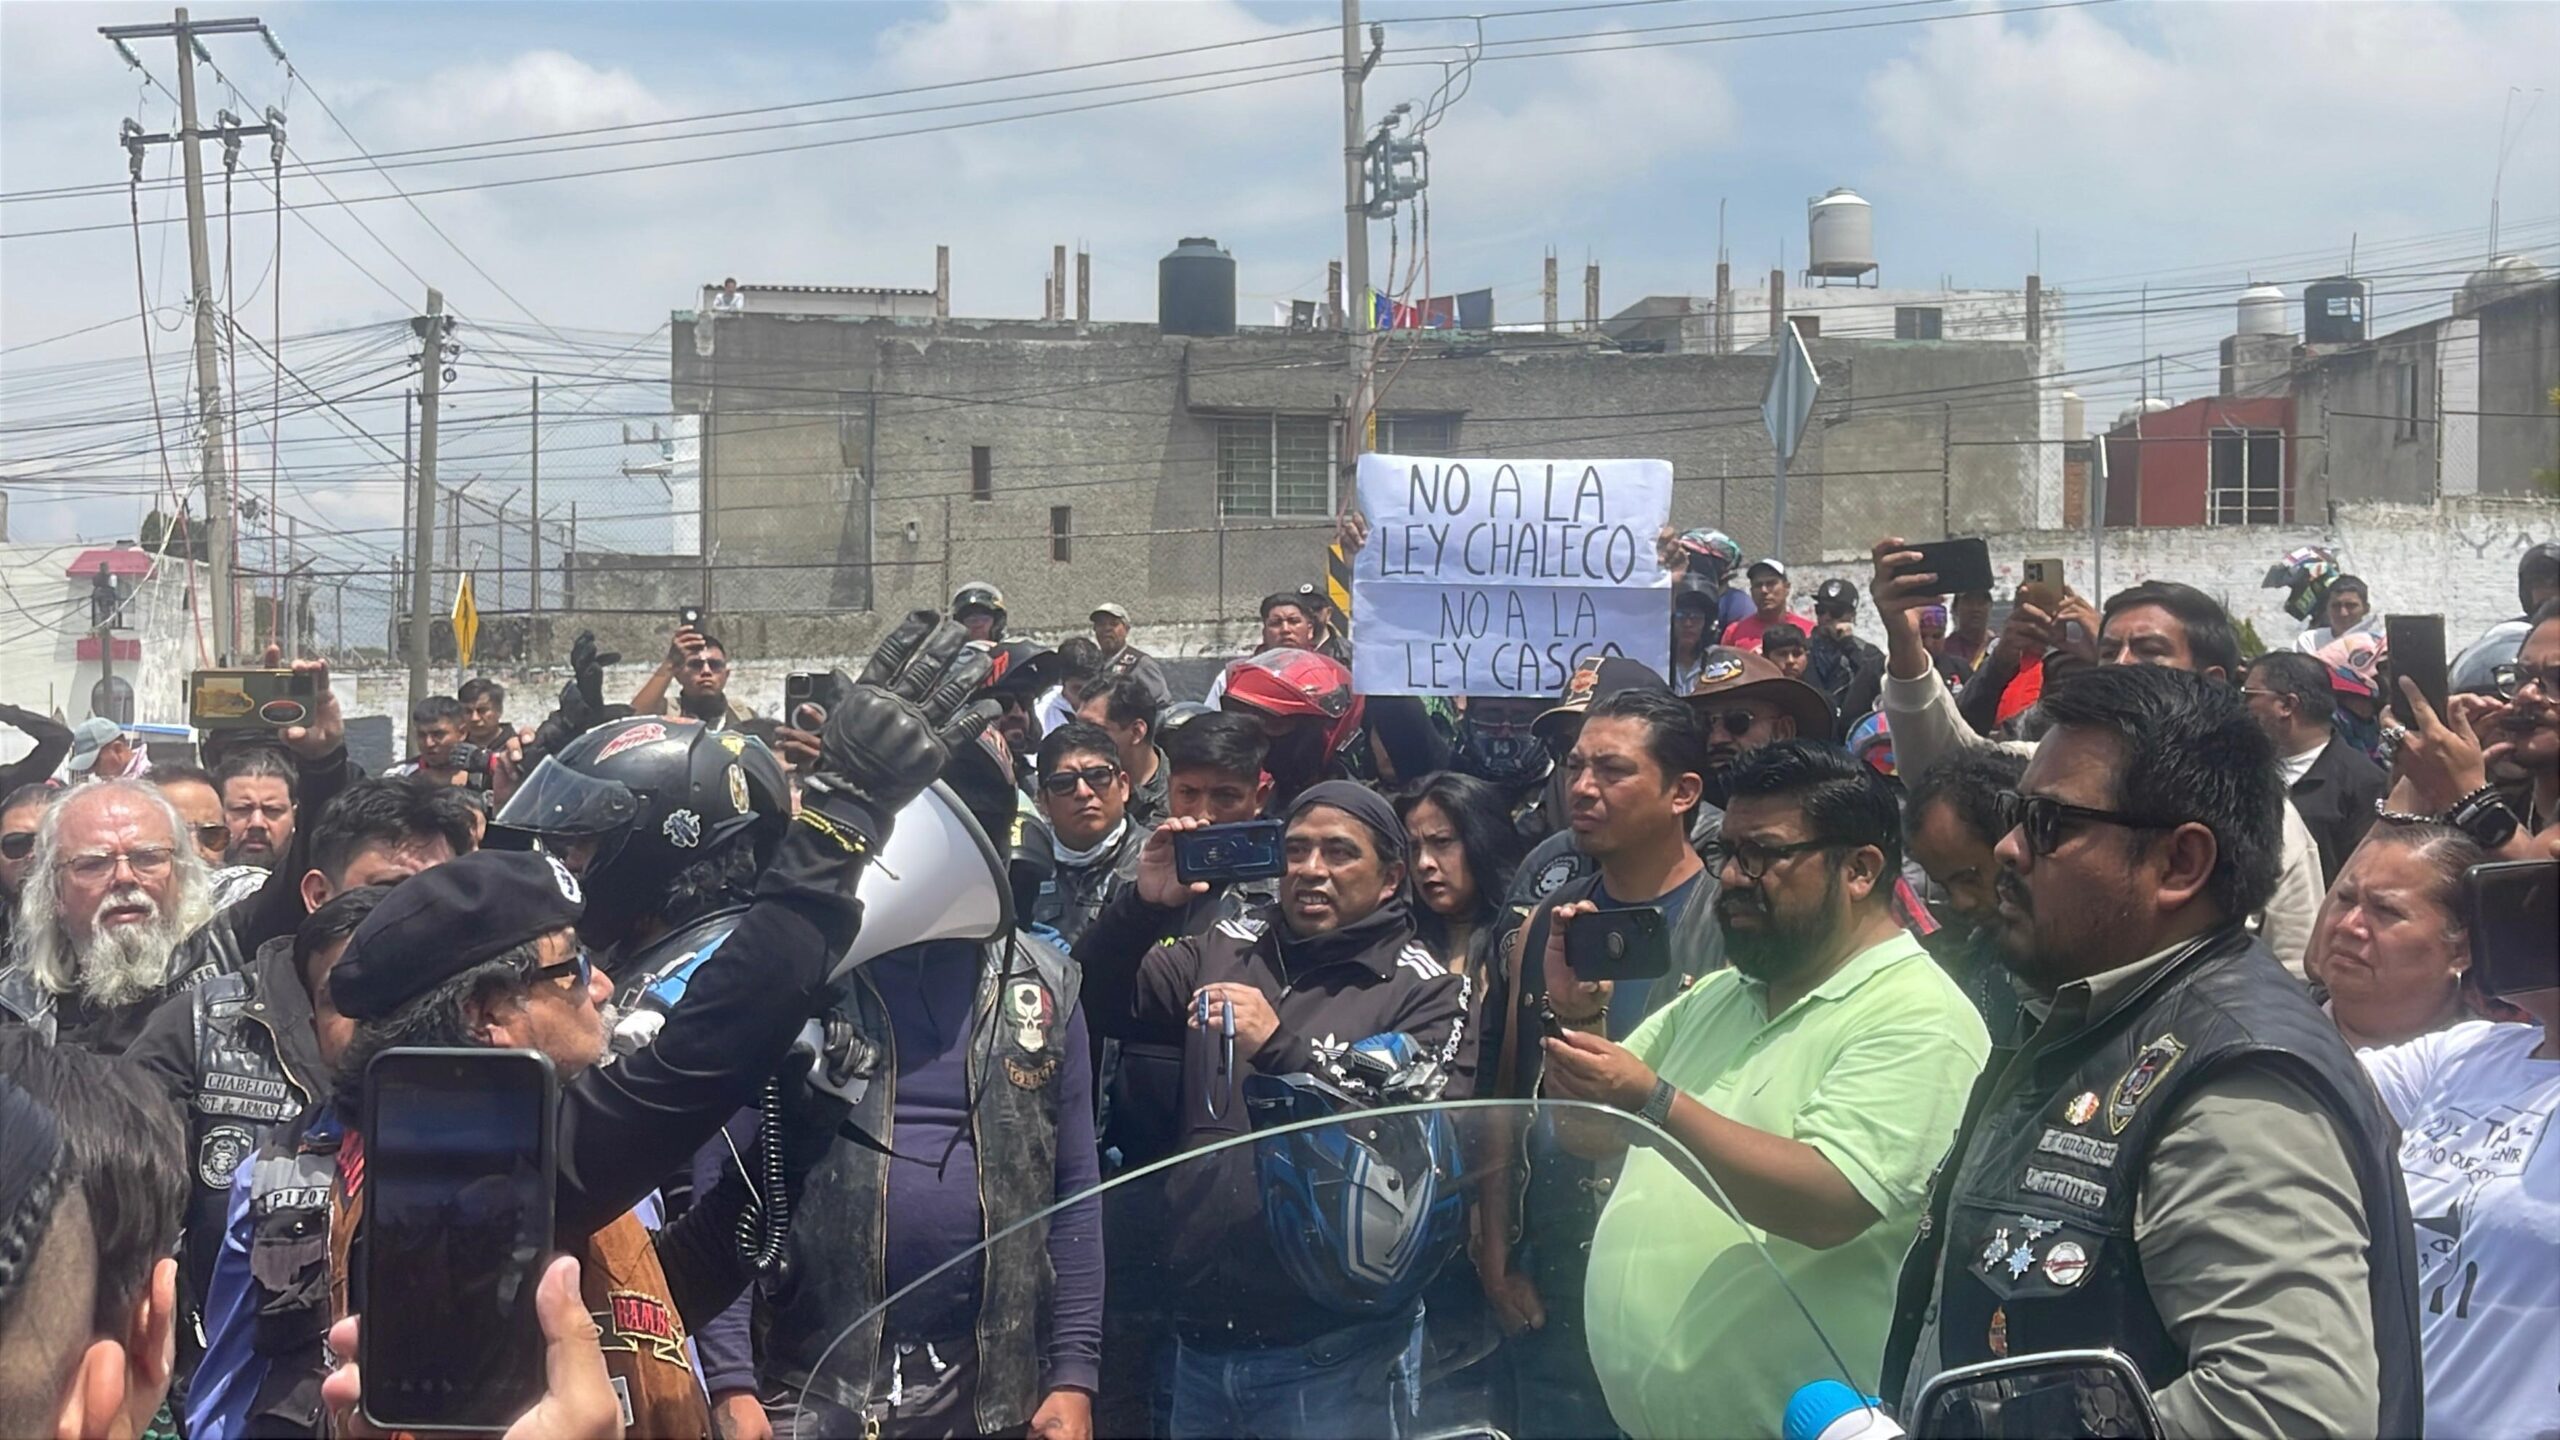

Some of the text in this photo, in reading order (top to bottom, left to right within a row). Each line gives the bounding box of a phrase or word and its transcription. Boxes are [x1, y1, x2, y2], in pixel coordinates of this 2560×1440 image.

[1409, 463, 1605, 523] NO A LA
[1380, 521, 1636, 584] LEY CHALECO
[1440, 589, 1598, 640] NO A LA
[1406, 643, 1472, 690] LEY
[1491, 642, 1625, 691] CASC
[207, 1074, 284, 1097] CHABELON
[238, 1100, 278, 1118] ARMAS
[614, 1298, 673, 1339] RAMB
